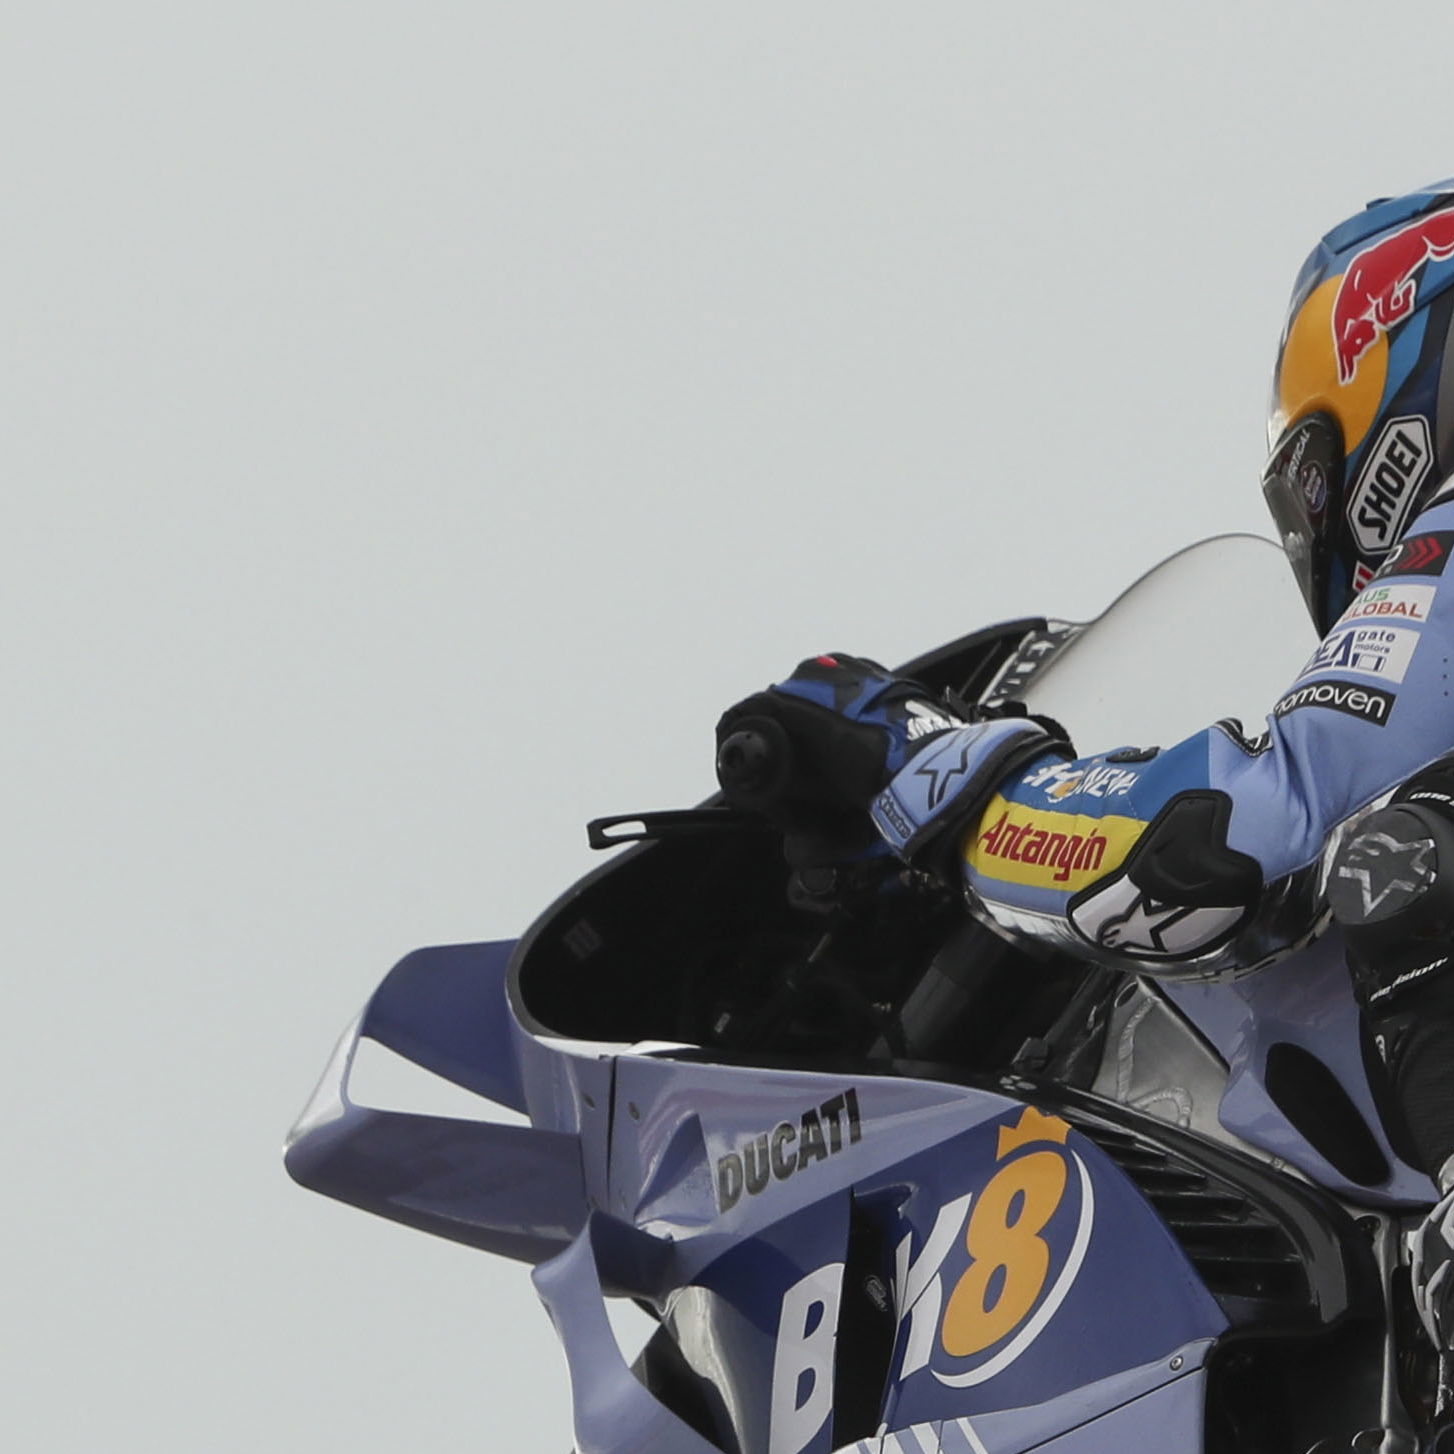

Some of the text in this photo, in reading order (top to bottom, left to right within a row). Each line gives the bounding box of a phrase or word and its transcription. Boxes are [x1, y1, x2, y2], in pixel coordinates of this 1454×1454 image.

[1358, 429, 1428, 542] SHOEI
[977, 809, 1108, 883] Antangin
[717, 1086, 863, 1214] DUCATI
